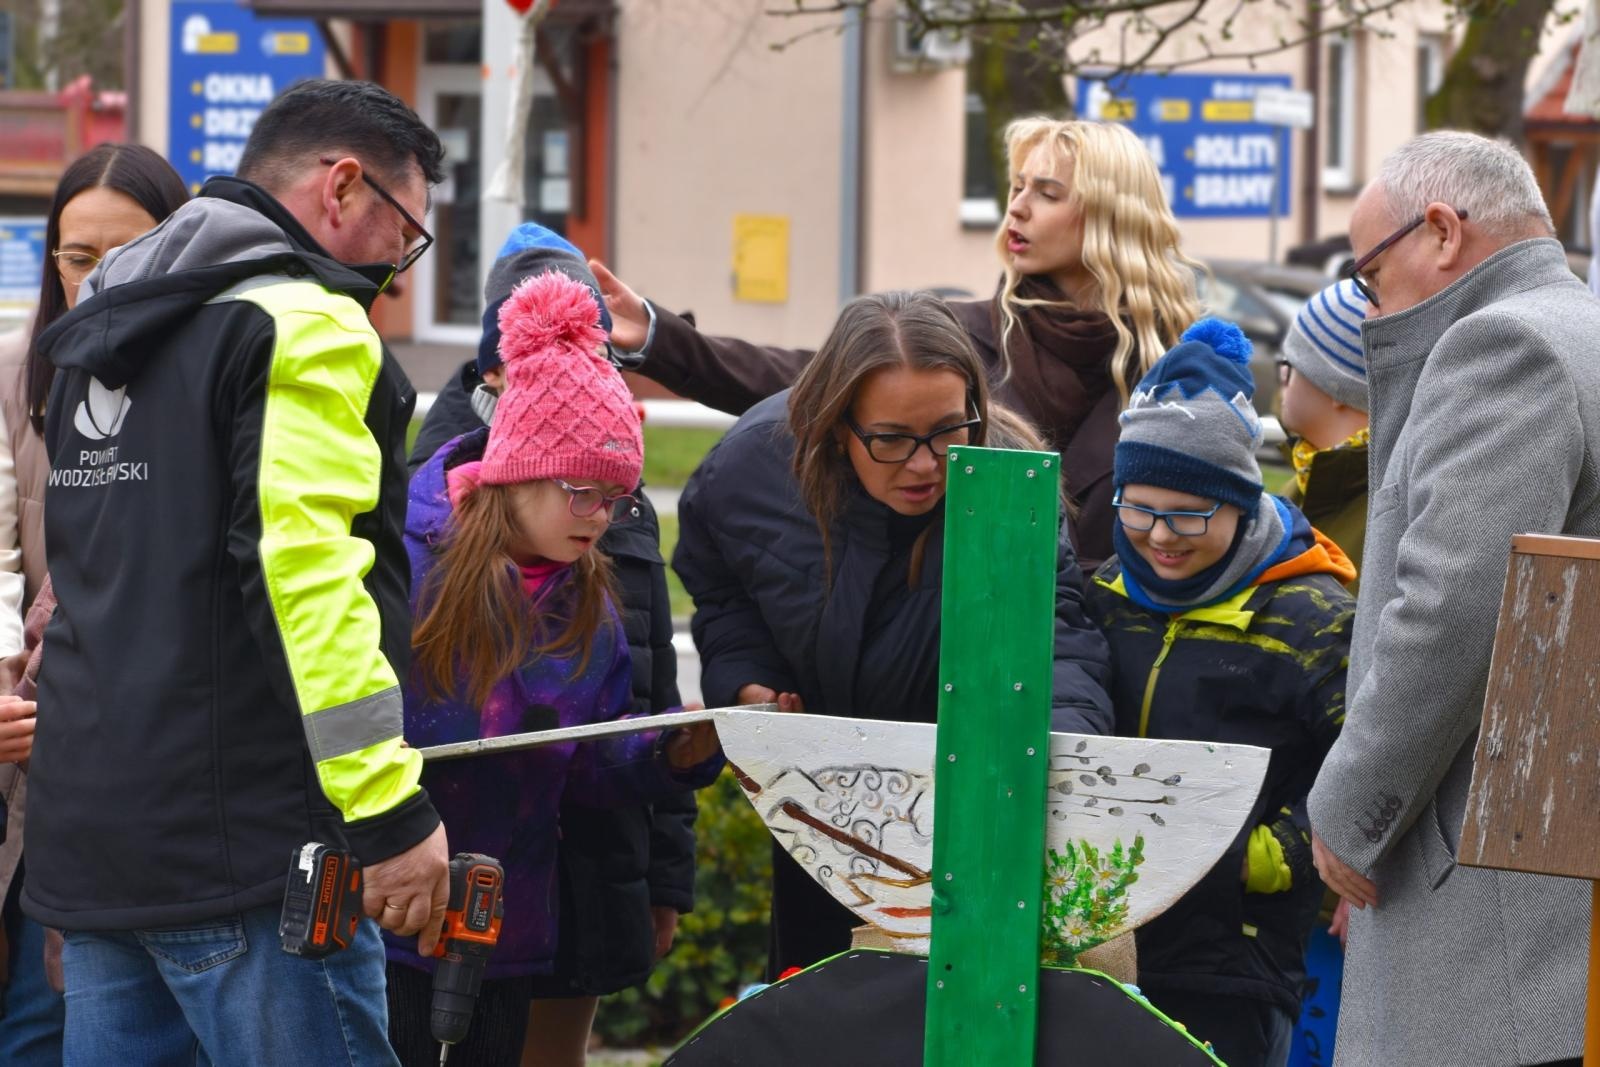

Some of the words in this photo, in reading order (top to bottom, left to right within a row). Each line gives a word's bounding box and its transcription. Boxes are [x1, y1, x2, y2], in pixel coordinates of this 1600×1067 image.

[204, 72, 274, 103] OKNA
[204, 107, 262, 136] DRZ
[1195, 135, 1276, 168] ROLETY
[1194, 175, 1276, 206] BRAMY
[80, 446, 118, 466] POWIAT
